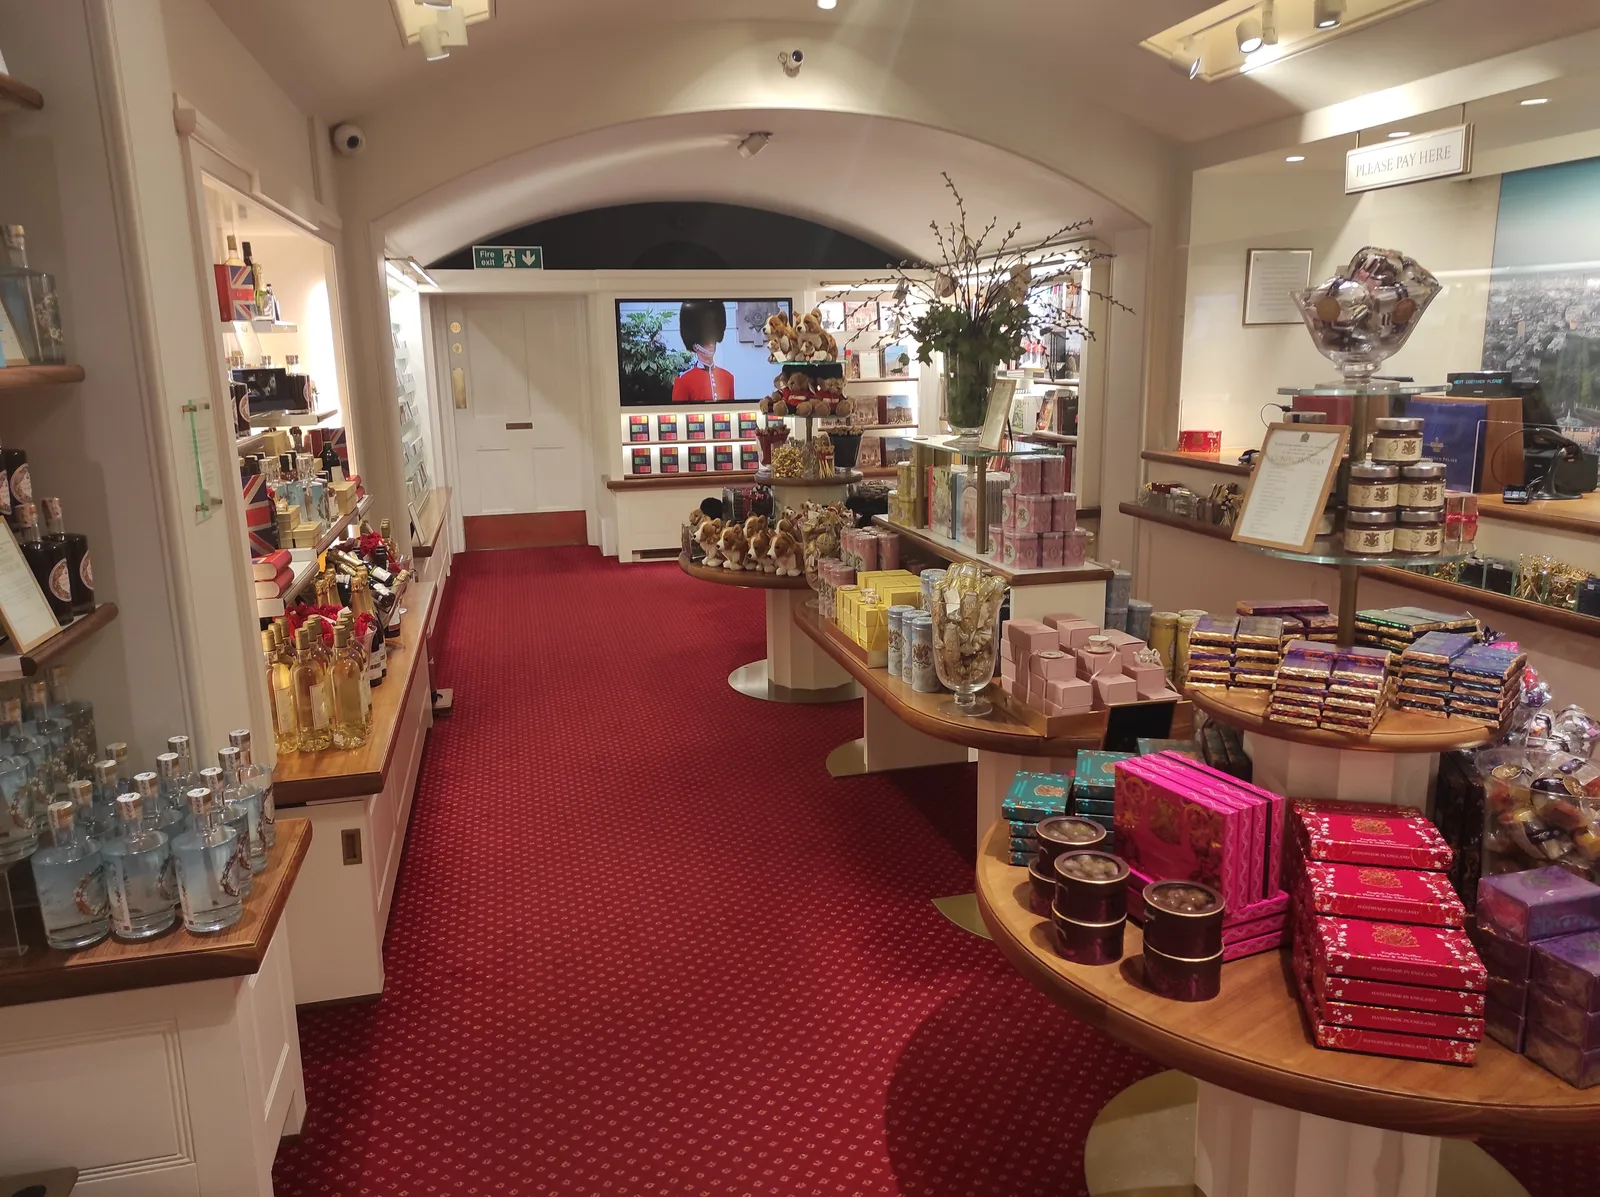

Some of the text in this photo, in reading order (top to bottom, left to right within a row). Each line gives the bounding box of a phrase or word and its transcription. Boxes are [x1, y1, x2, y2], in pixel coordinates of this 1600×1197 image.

[1355, 145, 1452, 178] PLEASE PAY HERE
[479, 250, 495, 258] Fire
